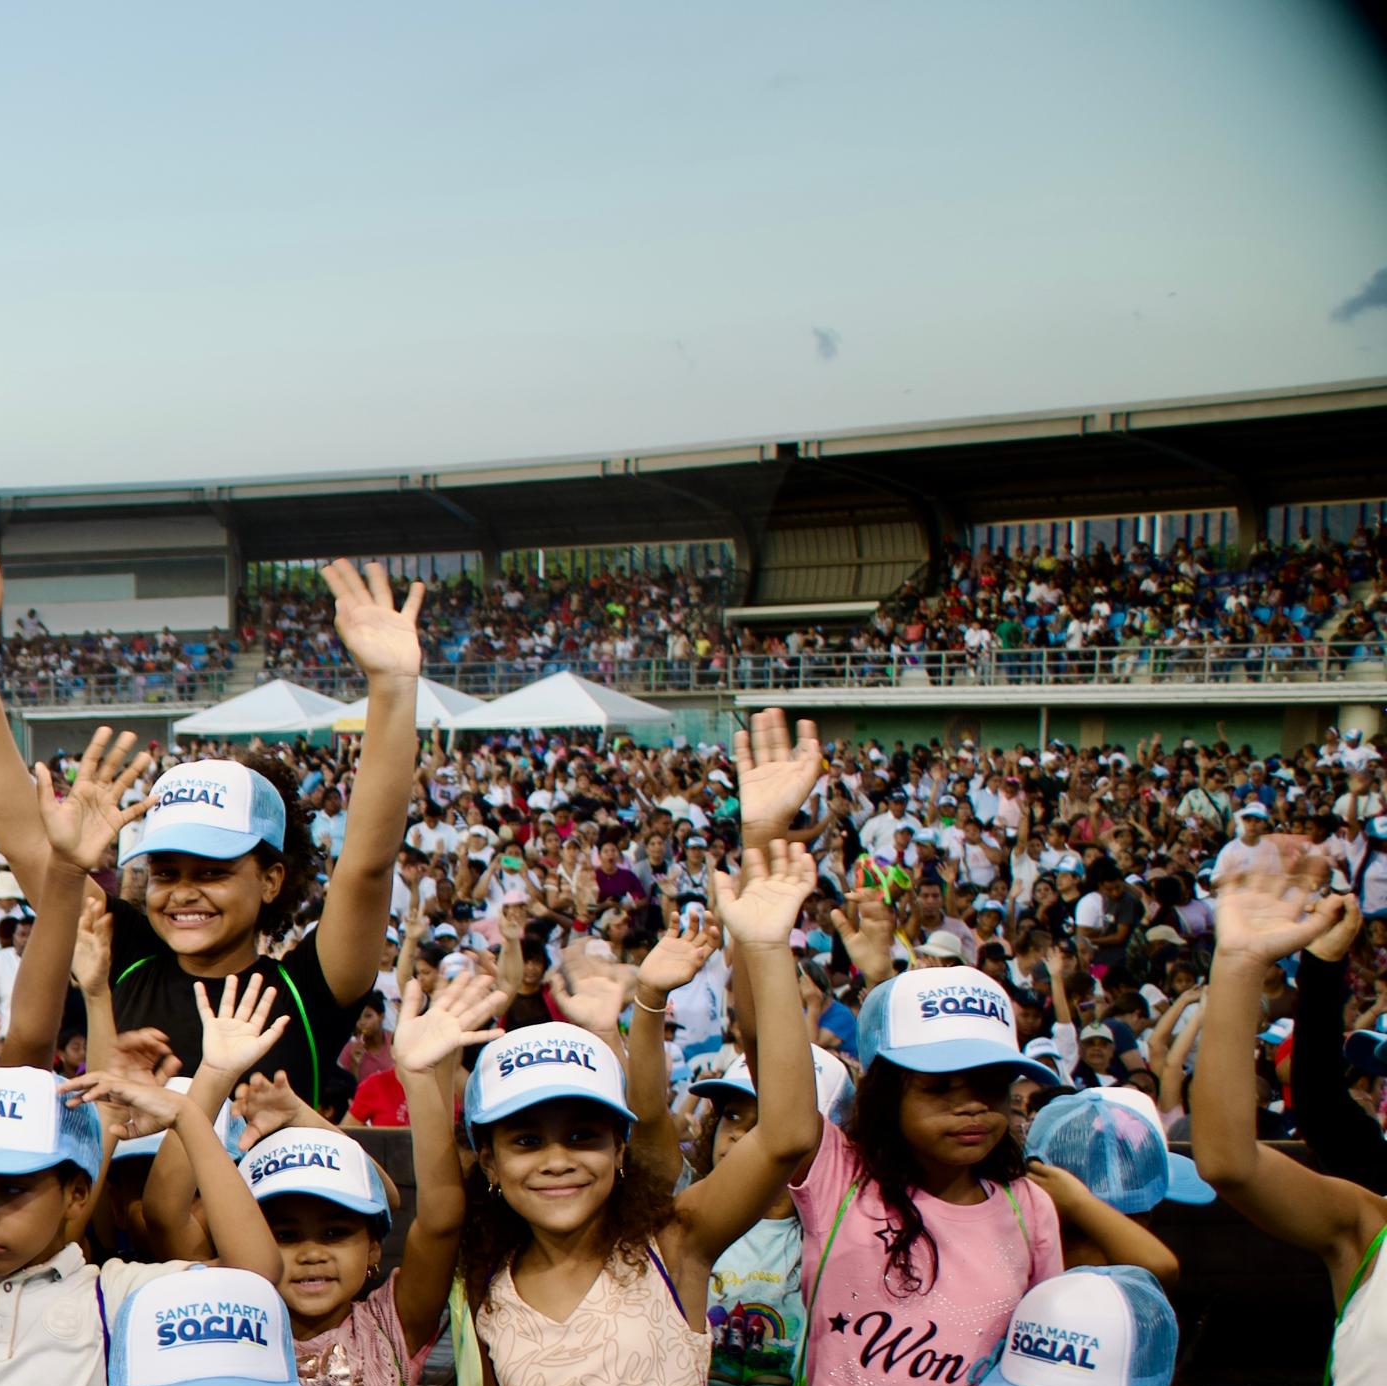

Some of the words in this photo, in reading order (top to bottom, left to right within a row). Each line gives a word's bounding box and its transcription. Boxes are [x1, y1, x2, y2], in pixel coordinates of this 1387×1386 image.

[154, 787, 224, 811] SOCIAL
[185, 778, 227, 794] MARTA
[917, 986, 966, 1002] SANTA
[971, 986, 1008, 1008] MARTA
[921, 997, 1010, 1028] SOCIAL
[496, 1040, 542, 1062] SANTA
[547, 1039, 595, 1056] MARTA
[499, 1048, 597, 1078] SOCIAL
[249, 1145, 288, 1171] SANTA
[292, 1143, 340, 1157] MARTA
[251, 1152, 341, 1185] SOCIAL
[155, 1301, 213, 1323] SANTA
[218, 1301, 268, 1324] MARTA
[156, 1316, 268, 1346] SOCIAL
[1013, 1320, 1043, 1336] SANTA
[1046, 1326, 1100, 1350] MARTA
[1011, 1332, 1096, 1370] SOCIAL
